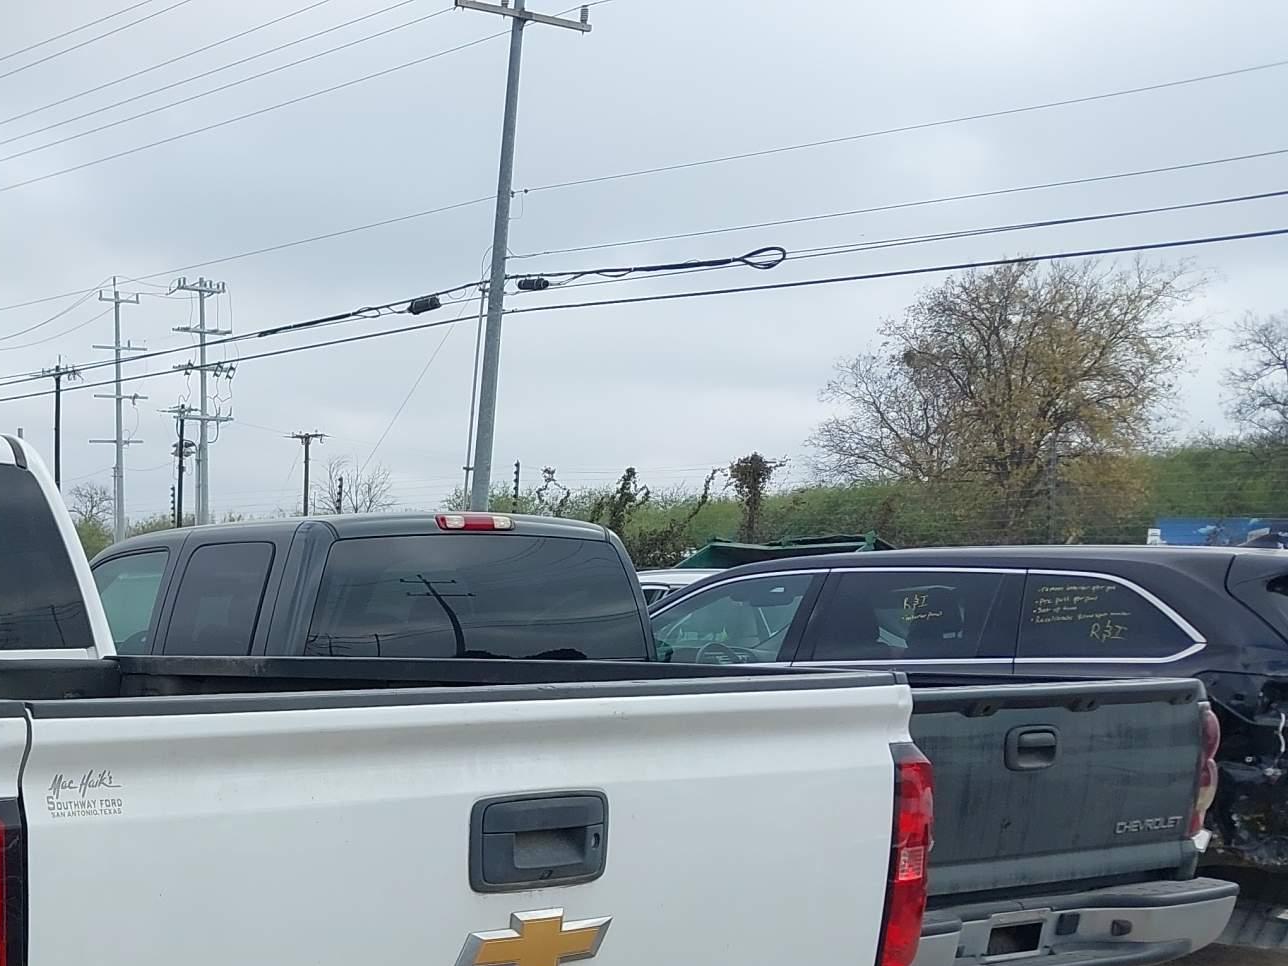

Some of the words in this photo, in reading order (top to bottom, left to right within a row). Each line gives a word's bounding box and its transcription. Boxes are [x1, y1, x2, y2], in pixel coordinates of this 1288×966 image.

[48, 774, 78, 799] Mac
[78, 769, 122, 799] Haik's
[99, 799, 123, 808] FORD
[1115, 816, 1183, 834] CHEVROLET
